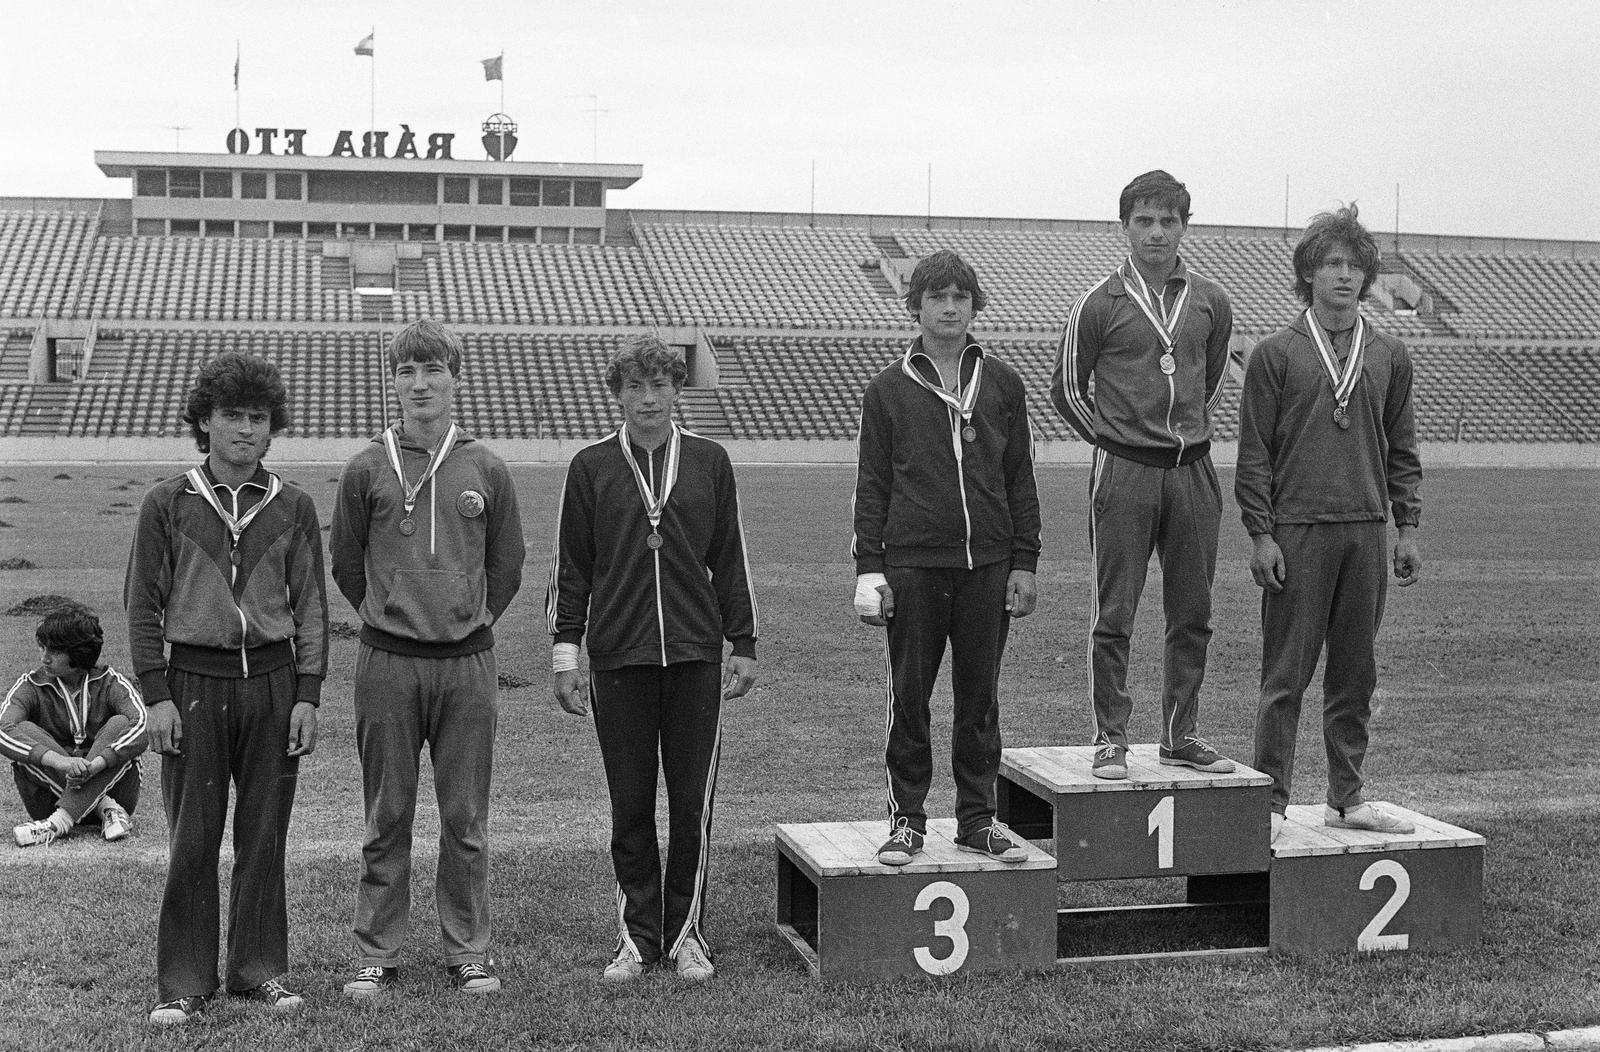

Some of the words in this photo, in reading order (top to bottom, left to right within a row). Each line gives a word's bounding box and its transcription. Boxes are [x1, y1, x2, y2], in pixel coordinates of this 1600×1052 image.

[1147, 795, 1175, 868] 1
[913, 881, 970, 976] 3
[1357, 859, 1411, 951] 2
